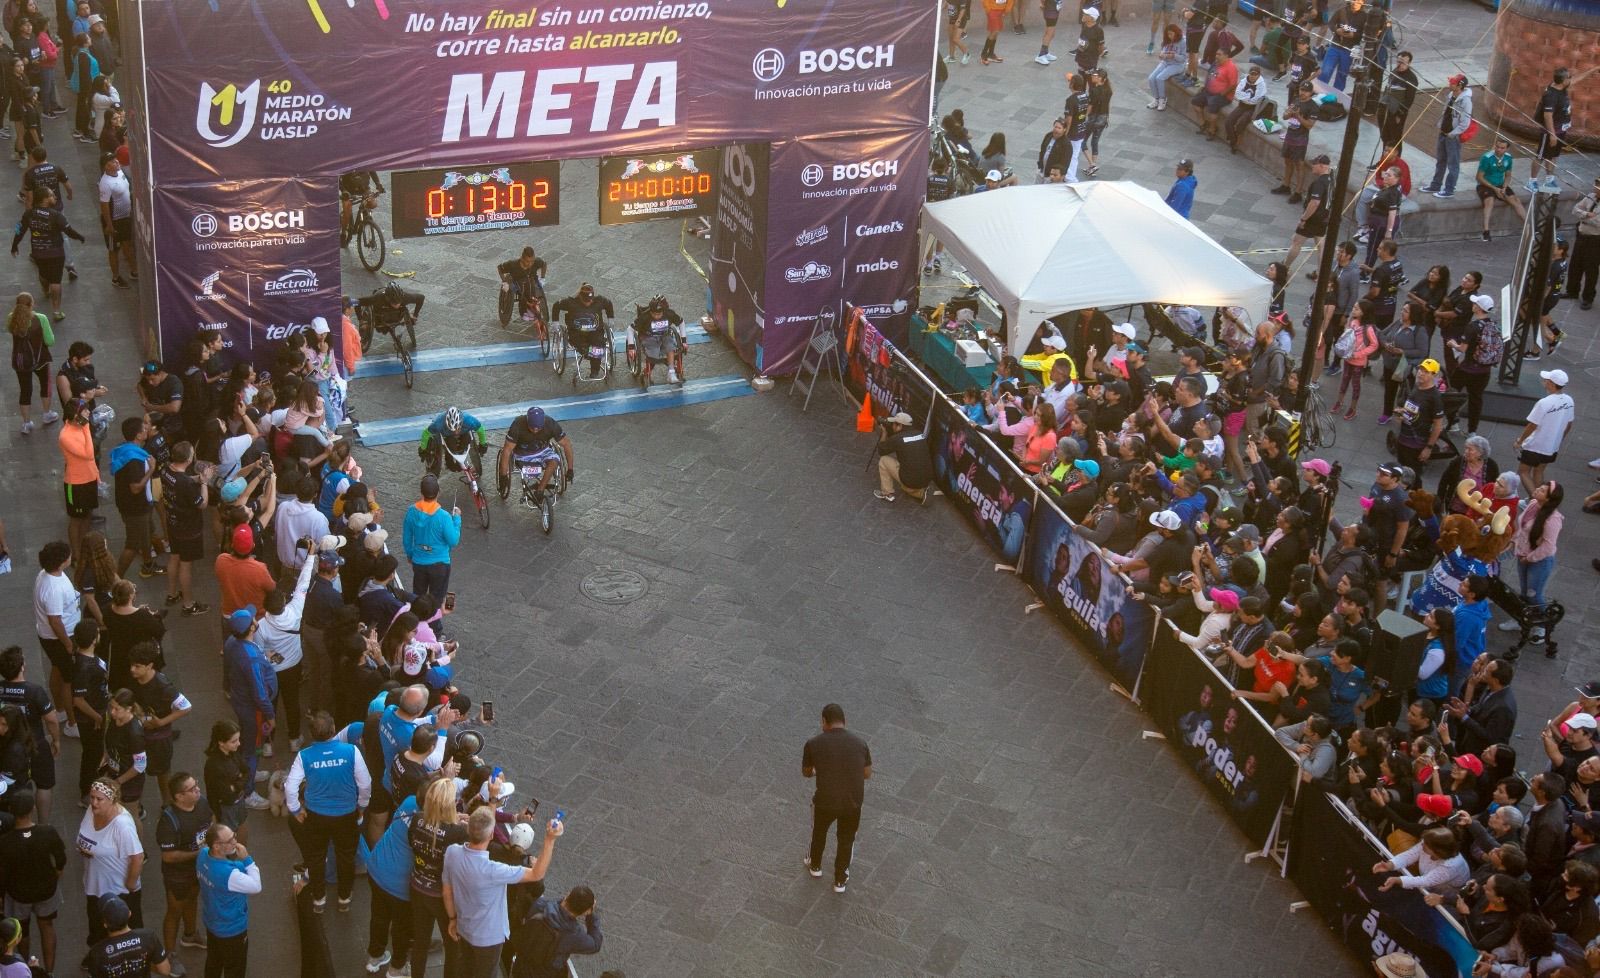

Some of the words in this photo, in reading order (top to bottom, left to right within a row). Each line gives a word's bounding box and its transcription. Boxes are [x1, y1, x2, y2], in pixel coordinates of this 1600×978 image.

[405, 14, 434, 33] No
[440, 13, 481, 35] hay
[485, 8, 537, 30] final
[539, 7, 570, 27] sin
[577, 9, 603, 25] un
[609, 1, 712, 22] comienzo,
[437, 38, 500, 57] corre
[505, 34, 565, 53] hasta
[570, 26, 683, 50] alcanzarlo.
[799, 44, 895, 74] BOSCH
[267, 79, 292, 94] 40
[754, 85, 821, 100] Innovación
[823, 83, 850, 97] para
[853, 82, 865, 92] tu
[867, 78, 892, 90] vida
[265, 94, 325, 109] MEDIO
[441, 61, 678, 142] META
[262, 105, 352, 124] MARATÓN
[260, 125, 318, 140] UASLP
[833, 160, 898, 181] BOSCH
[609, 174, 711, 202] 24:00:00
[802, 187, 848, 199] Innovación
[849, 187, 868, 196] para
[880, 182, 897, 191] vida
[427, 181, 549, 218] 0:13:02
[229, 210, 305, 232] BOSCH
[426, 217, 438, 226] Tu
[441, 215, 475, 225] tiempo
[486, 211, 526, 221] tiempo
[856, 221, 904, 237] Canel's
[195, 238, 249, 251] Innovación
[250, 238, 272, 248] para
[274, 237, 284, 245] tu
[285, 234, 305, 244] vida
[856, 258, 899, 273] mabe
[264, 276, 319, 291] Electrolit
[313, 758, 345, 769] UASLP
[1192, 724, 1245, 789] poder
[116, 937, 141, 950] BOSCH
